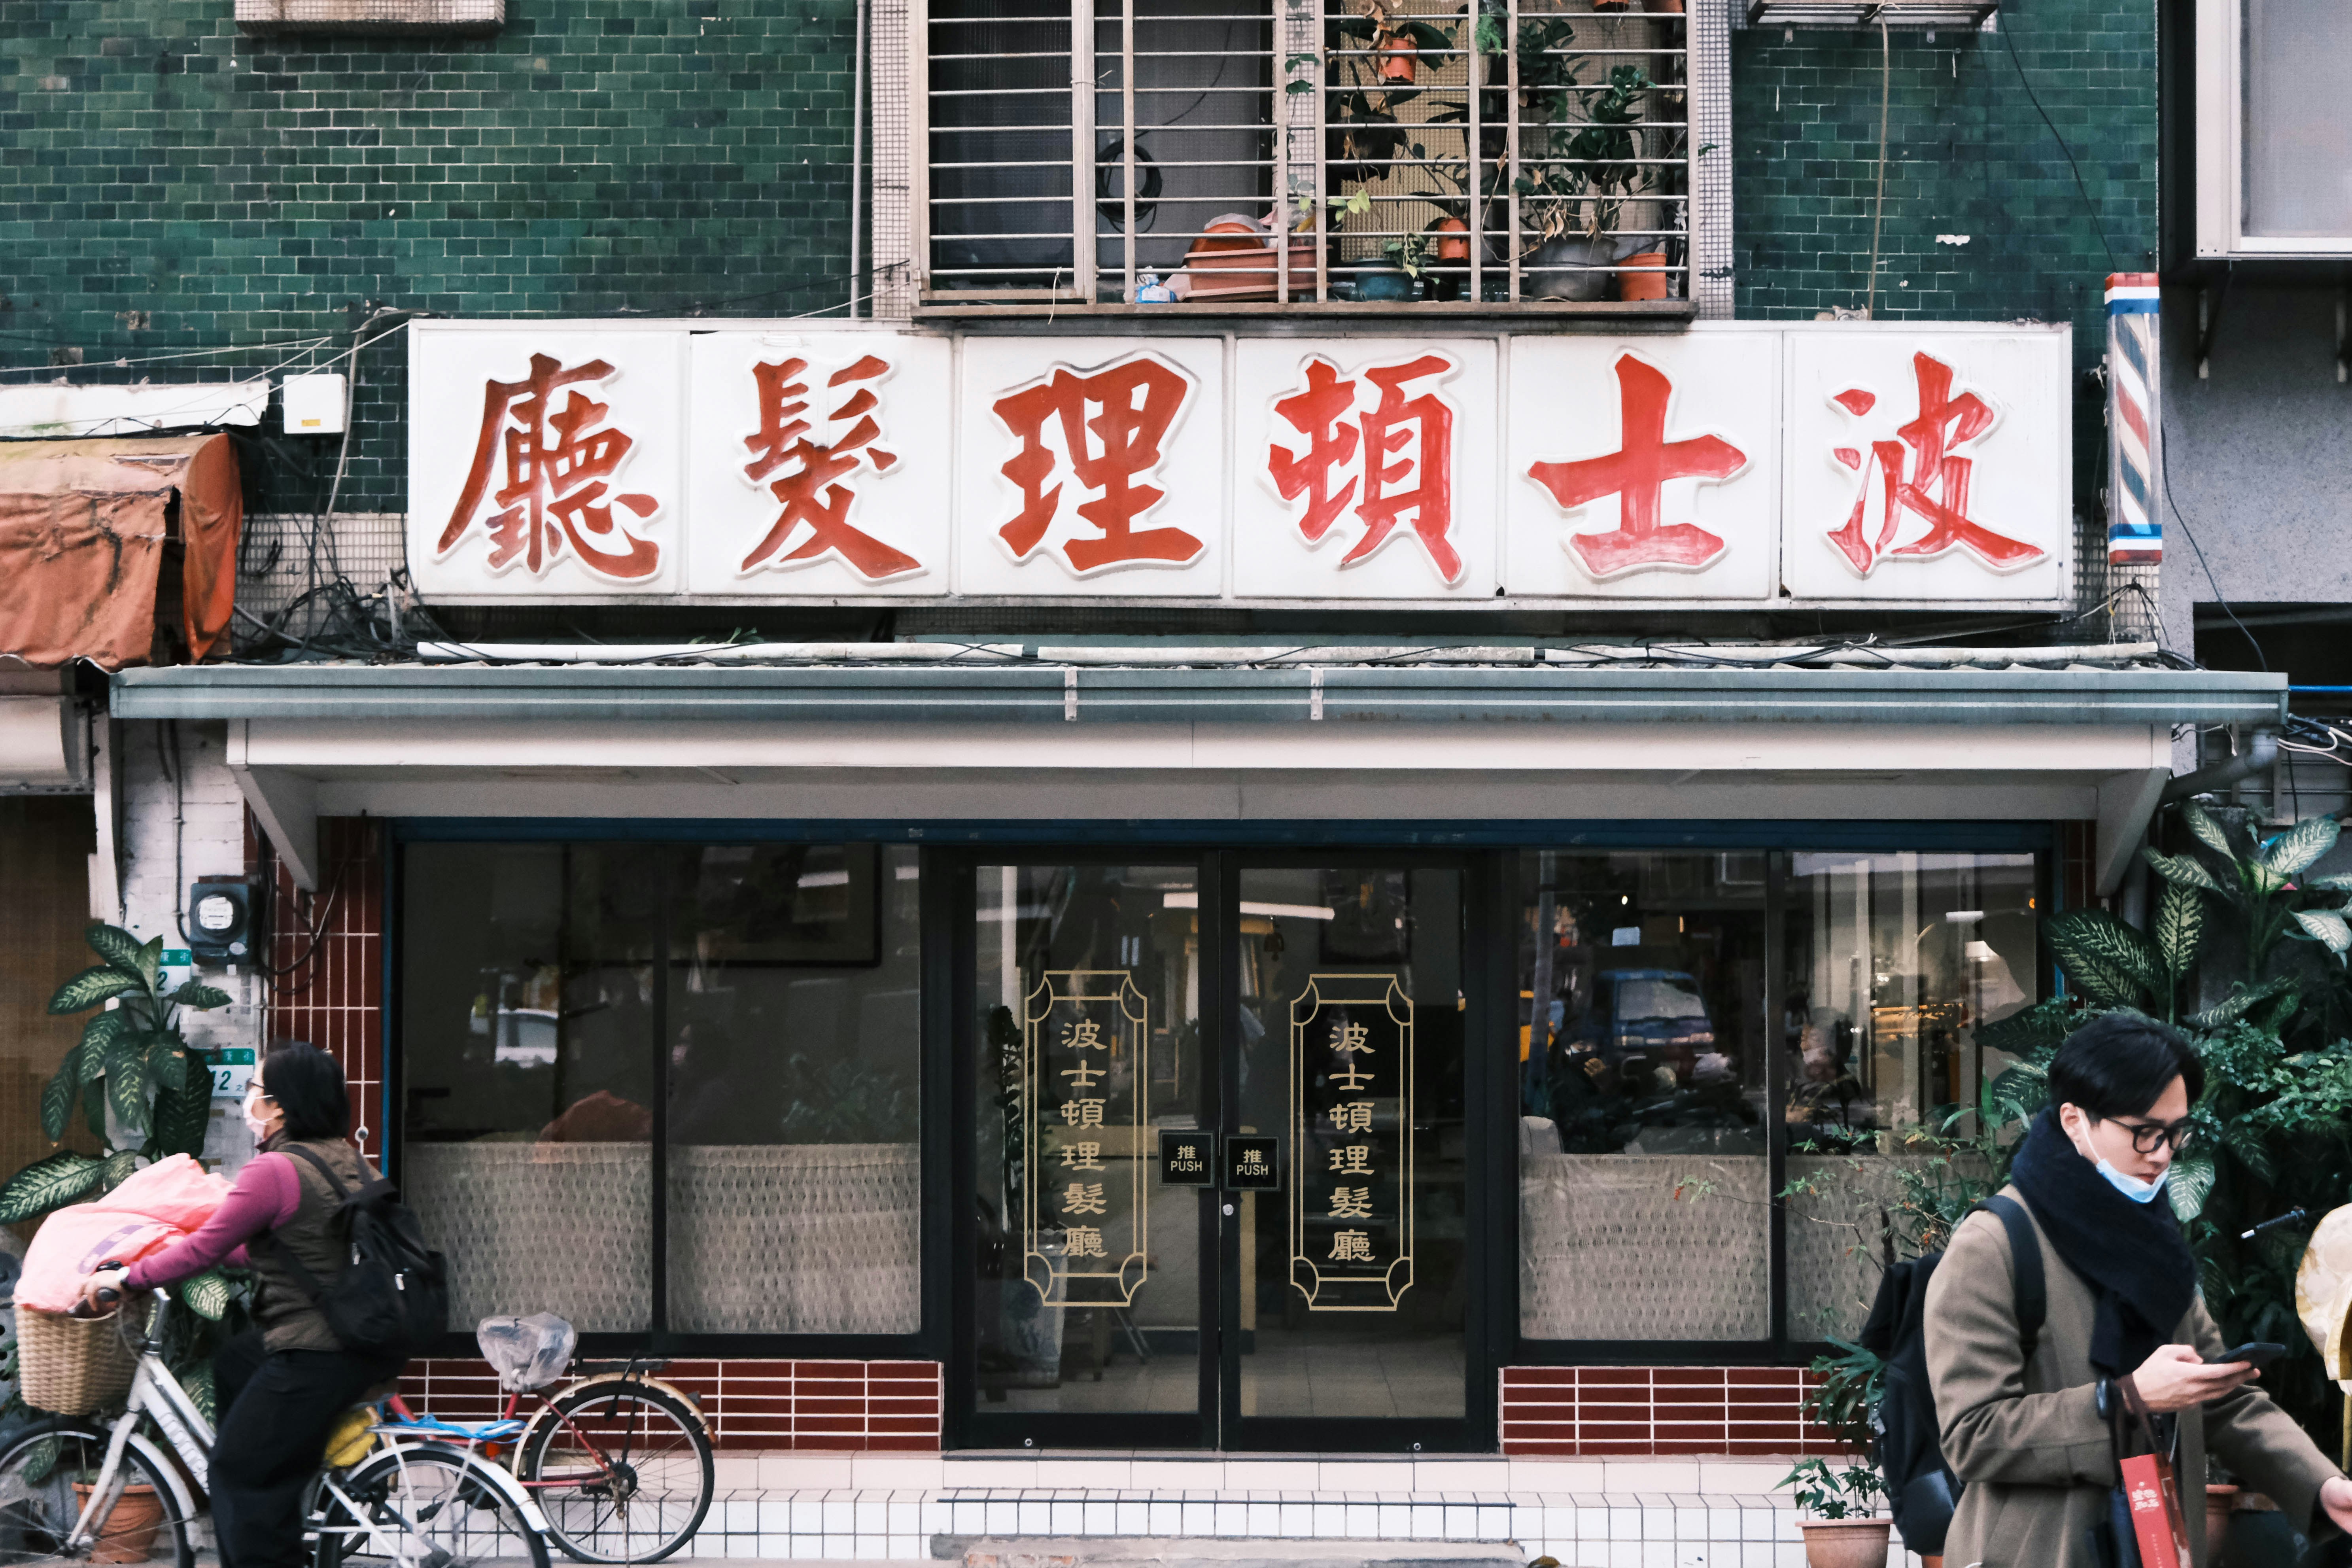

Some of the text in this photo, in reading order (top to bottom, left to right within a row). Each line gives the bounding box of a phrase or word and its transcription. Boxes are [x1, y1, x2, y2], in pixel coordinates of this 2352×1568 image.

[437, 351, 2046, 583] 波士頓理髮廳
[1060, 1018, 1107, 1258] 波士頓理髮廳
[1328, 1022, 1375, 1262] 波士頓理髮廳
[1177, 1145, 1196, 1159] 推
[1243, 1149, 1262, 1163] 推
[1170, 1161, 1202, 1172] PUSH
[1236, 1165, 1269, 1176] PUSH
